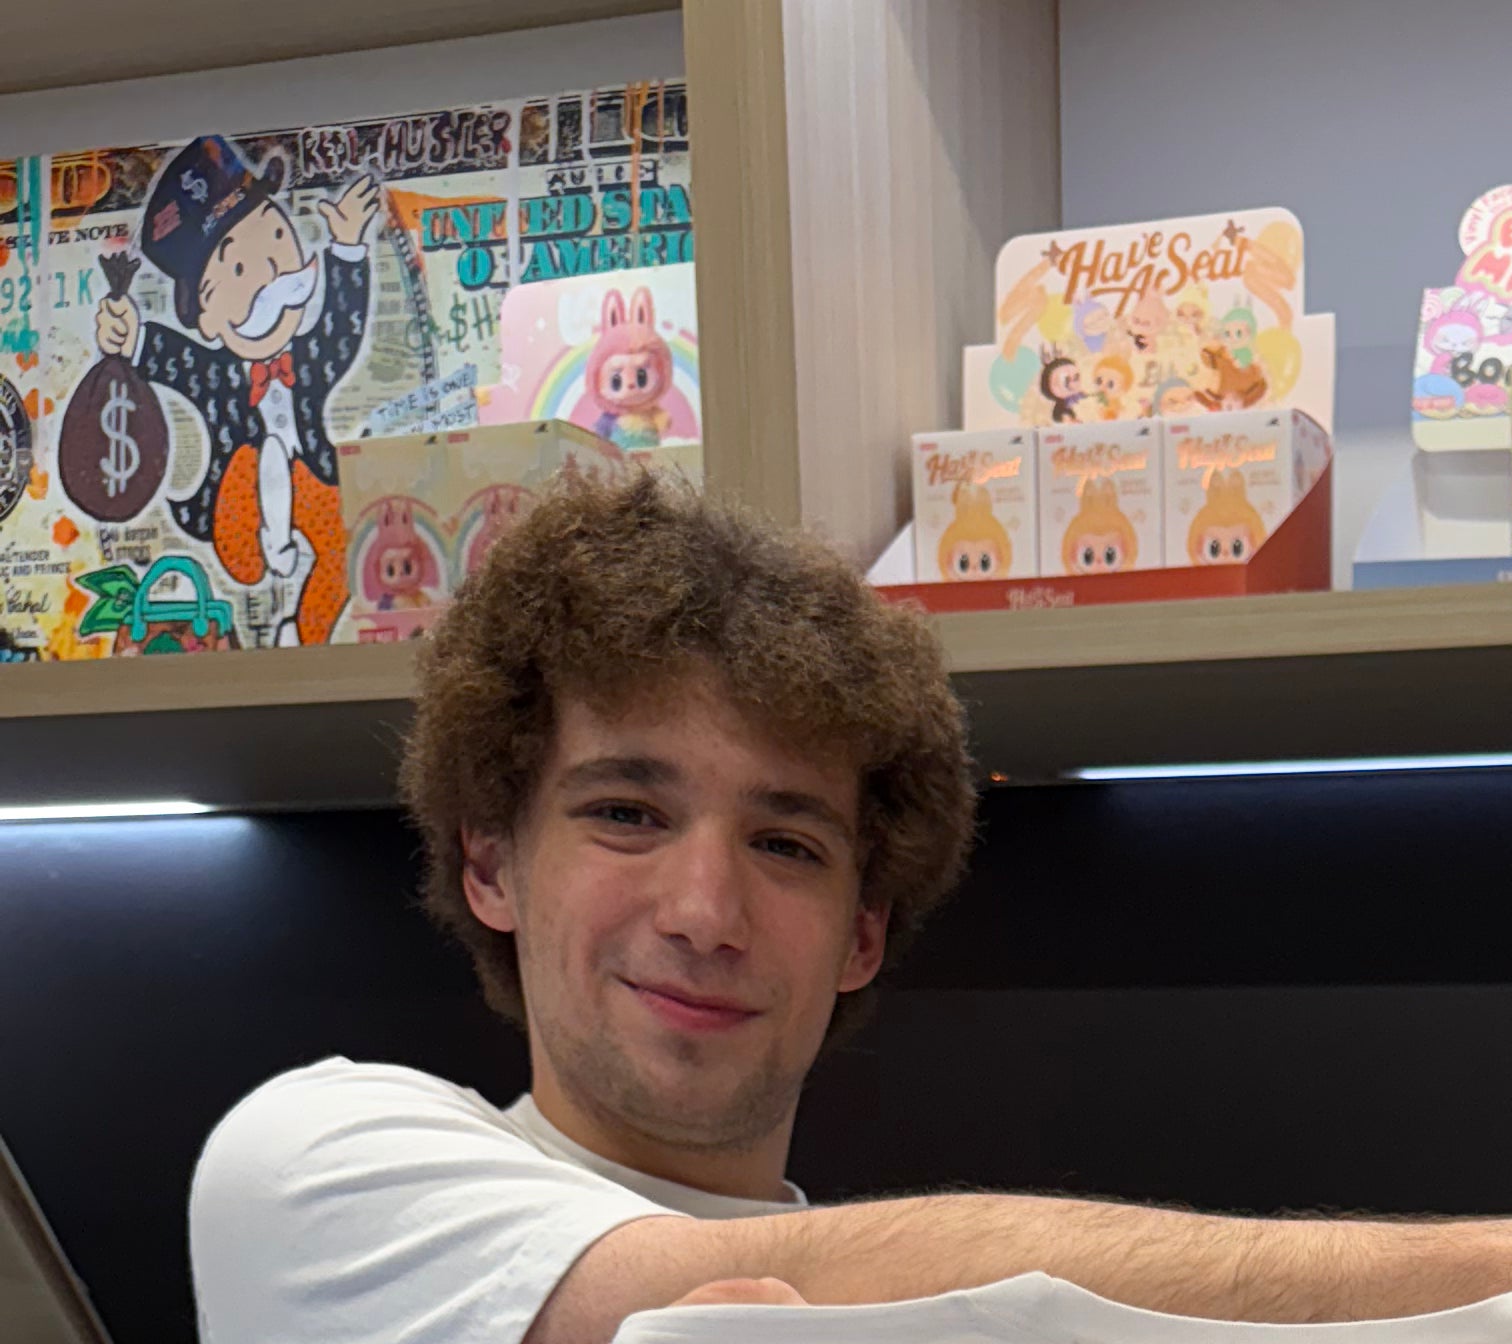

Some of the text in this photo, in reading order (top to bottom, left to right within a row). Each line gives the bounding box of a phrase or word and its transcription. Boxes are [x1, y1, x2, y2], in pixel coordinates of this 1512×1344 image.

[75, 223, 130, 242] NOTE
[1058, 230, 1164, 305] Have
[1155, 231, 1248, 297] Seat
